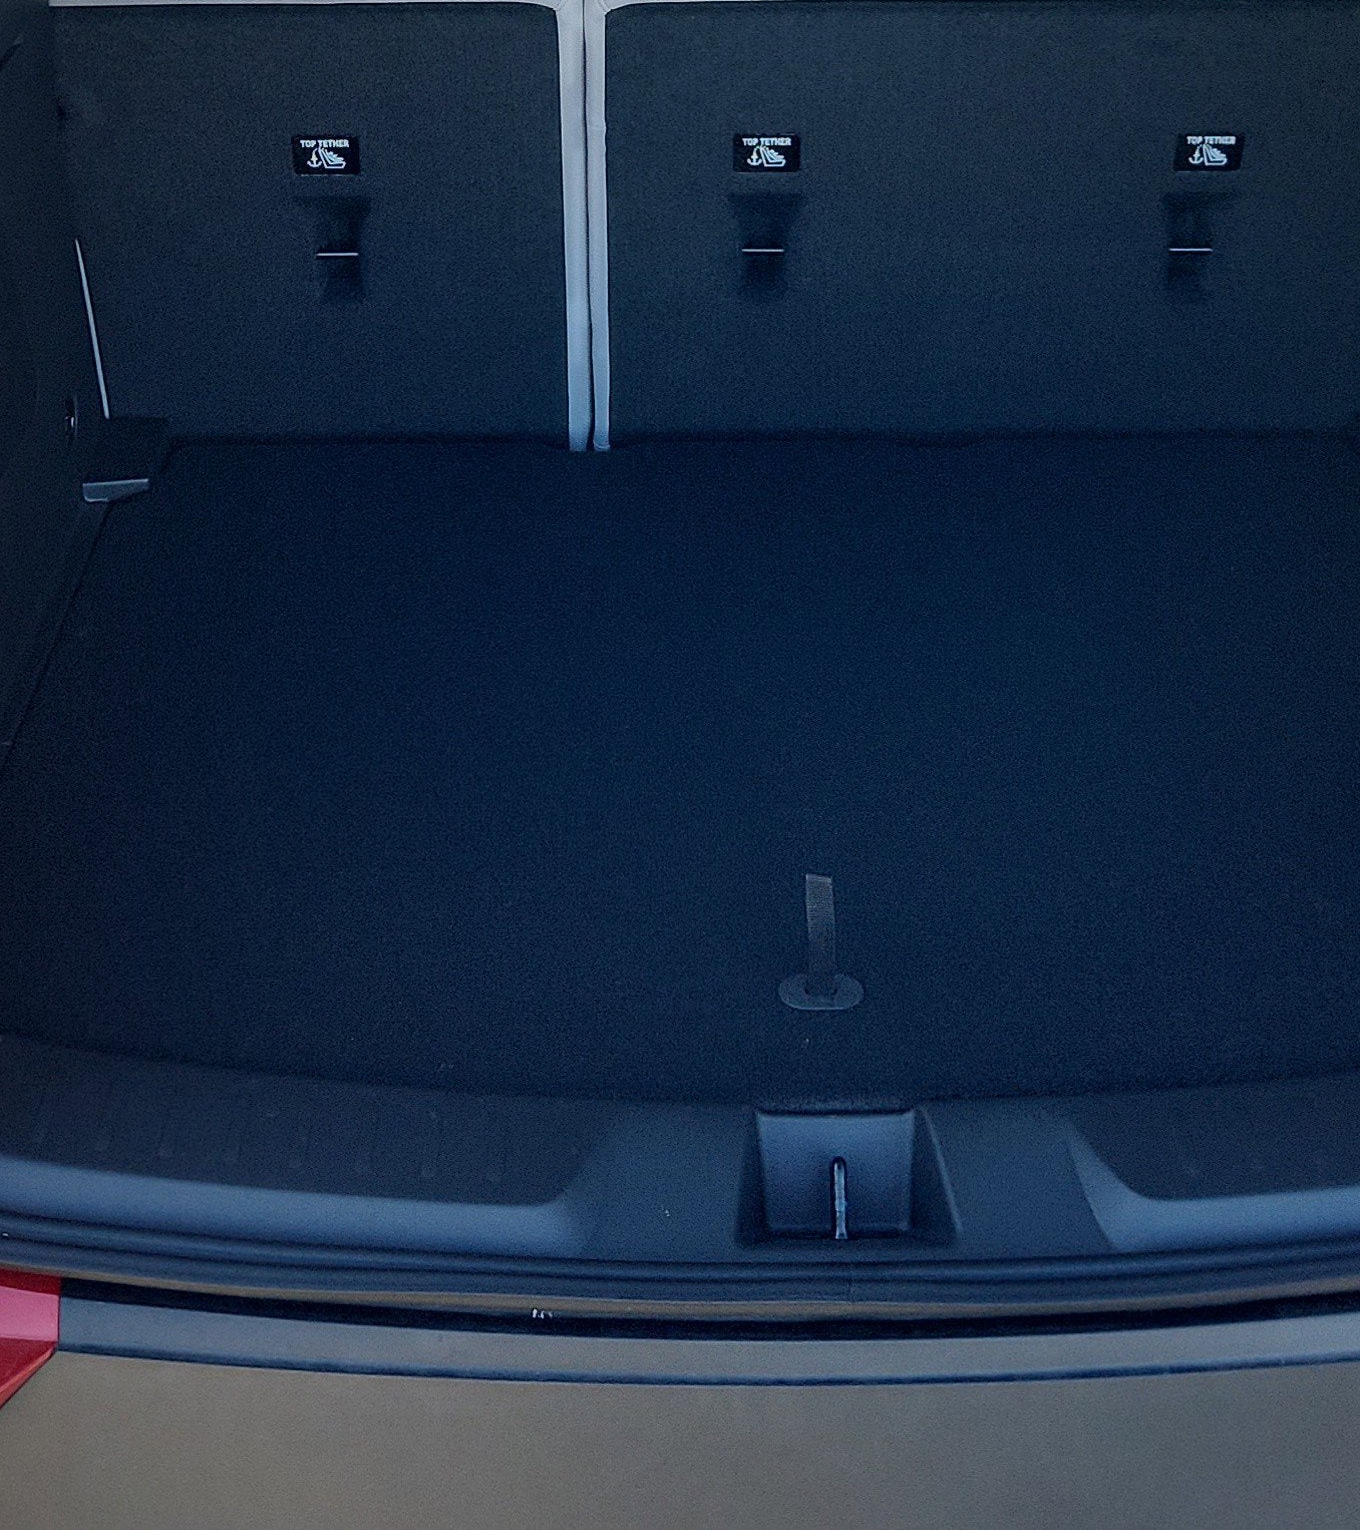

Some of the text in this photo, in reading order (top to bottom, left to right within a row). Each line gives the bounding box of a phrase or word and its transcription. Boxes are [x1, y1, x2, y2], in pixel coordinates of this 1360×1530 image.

[299, 139, 350, 148] TOP TETHER
[742, 137, 792, 146] TOP TETHER
[1186, 136, 1237, 145] TOP TETHER
